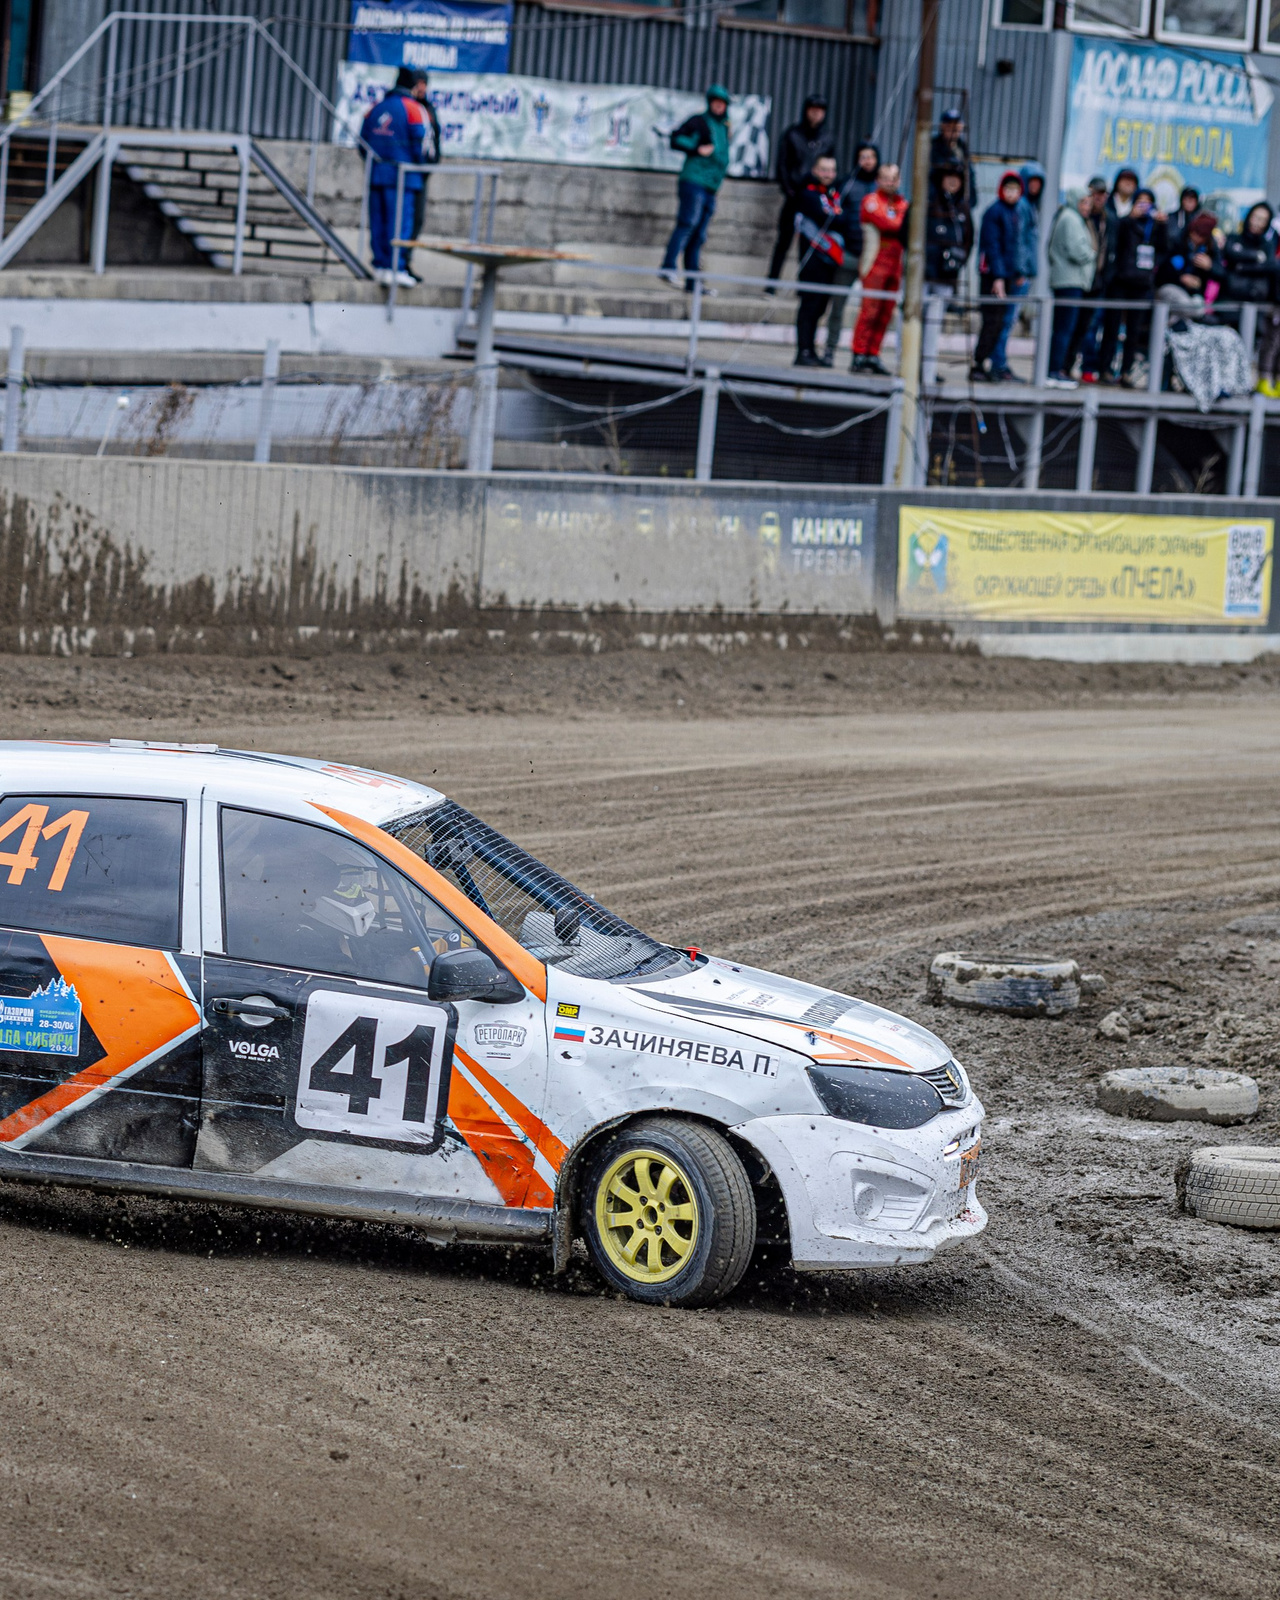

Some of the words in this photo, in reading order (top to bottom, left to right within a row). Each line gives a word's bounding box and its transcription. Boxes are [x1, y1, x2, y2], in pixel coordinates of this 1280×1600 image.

[1098, 118, 1234, 177] АВТОШКОЛА
[791, 516, 863, 546] КАНКУН
[968, 529, 1067, 553] ОБЩЕСТВЕННАЯ
[973, 571, 1062, 598] ОКРУЖАЮЩЕЙ
[1110, 565, 1196, 600] «ПЧЕЛА»
[4, 1006, 34, 1017] ГАЗПРОМ
[558, 1006, 578, 1015] OMP
[38, 1019, 75, 1031] 28-30/06
[25, 1031, 74, 1050] СИБИРИ
[478, 1028, 523, 1043] РЕТРОПАРК
[50, 1043, 74, 1053] 2024
[228, 1040, 280, 1059] VOLGA
[589, 1026, 744, 1071] ЗАЧИНЯЕВА
[753, 1053, 776, 1077] П.
[308, 1016, 436, 1124] 41
